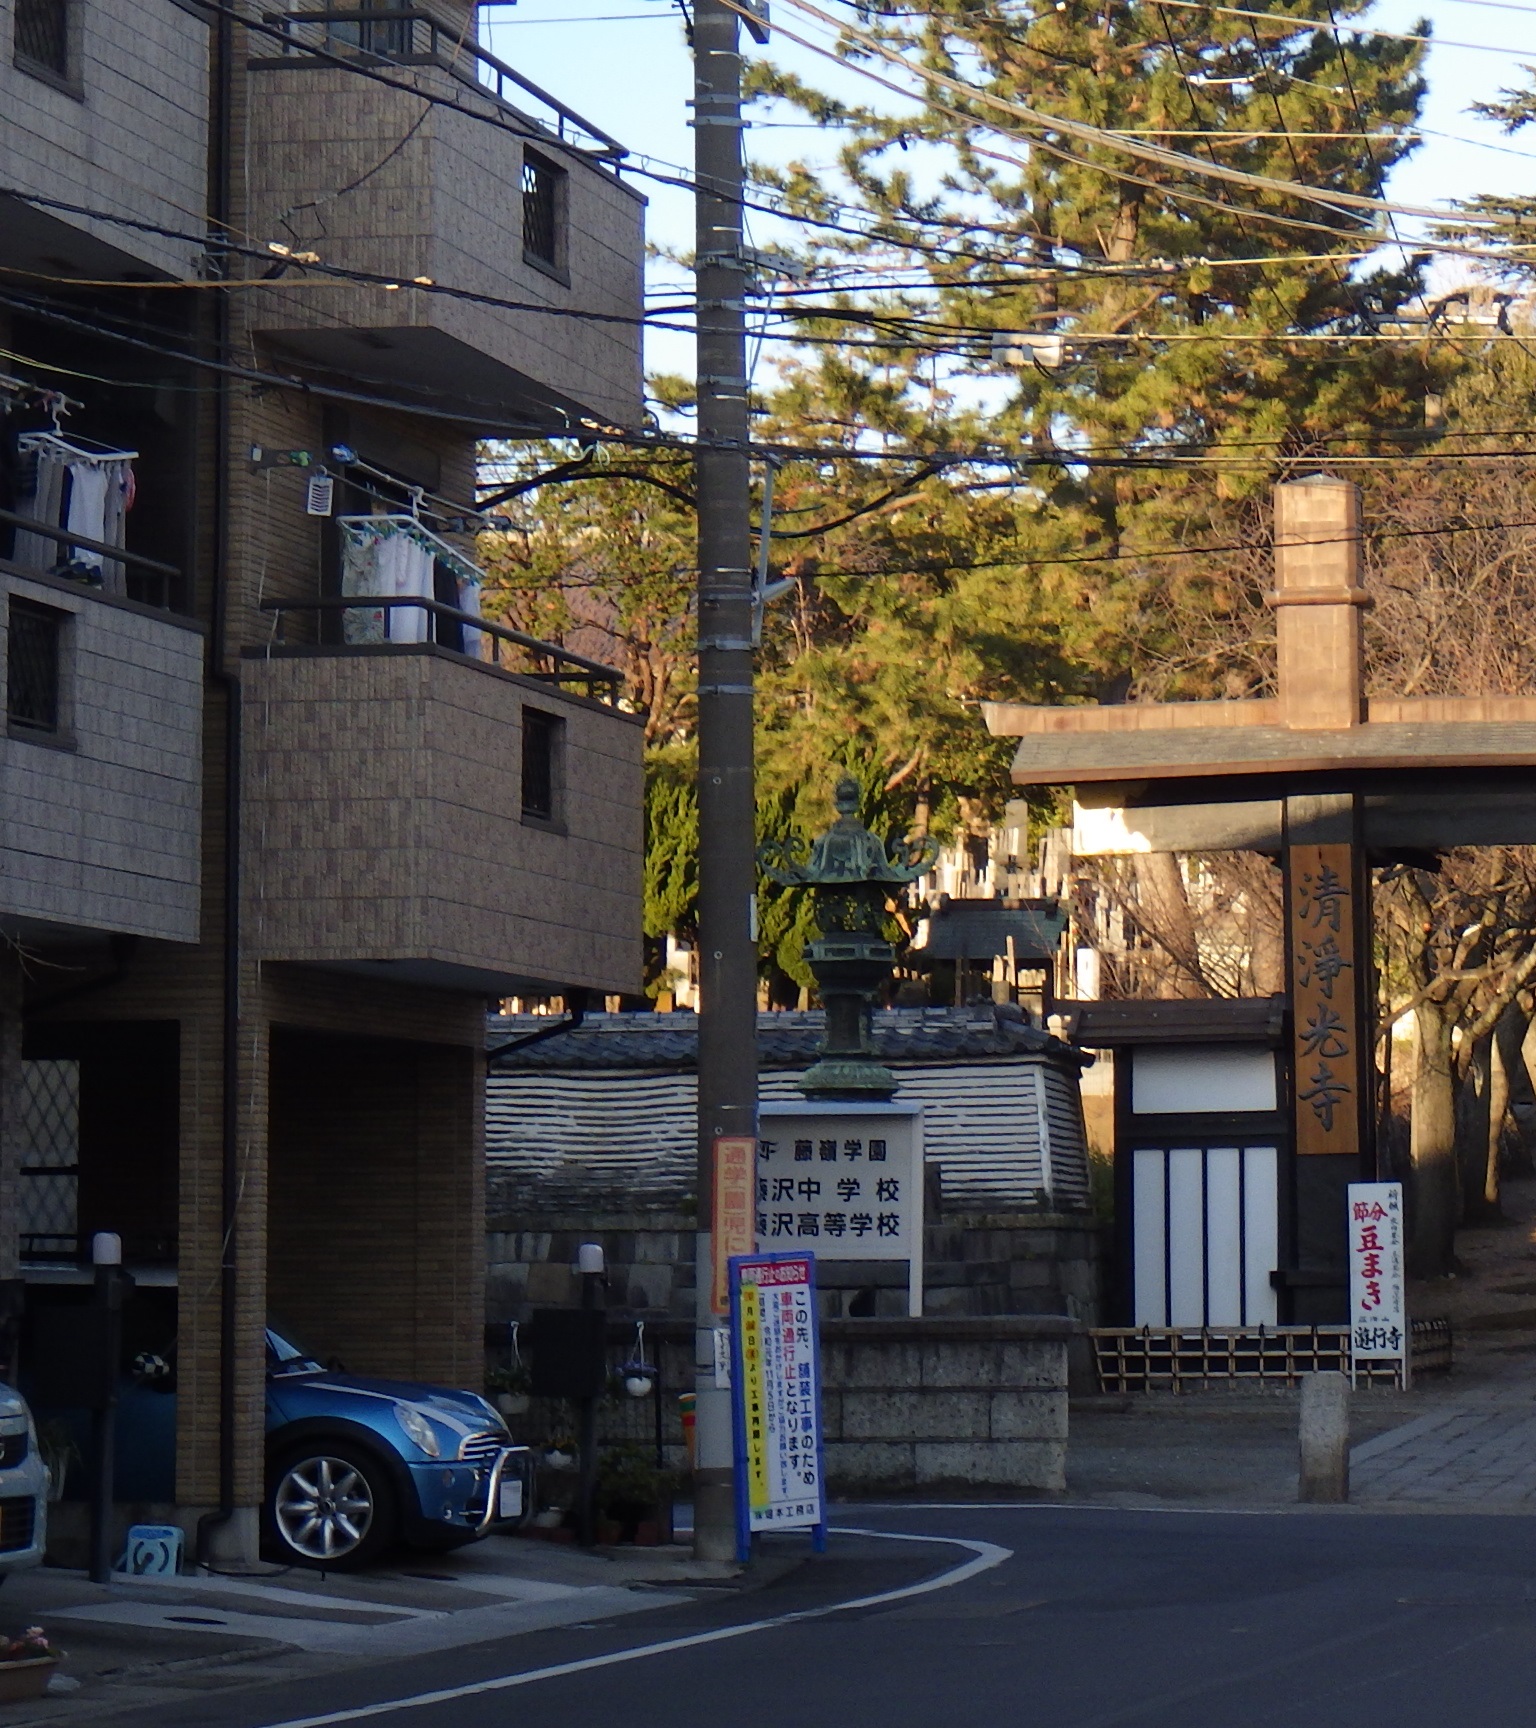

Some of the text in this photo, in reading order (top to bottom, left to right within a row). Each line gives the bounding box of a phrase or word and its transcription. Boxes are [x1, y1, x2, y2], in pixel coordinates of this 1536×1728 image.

[1353, 1201, 1388, 1223] 節分
[1356, 1225, 1385, 1311] 豆まき
